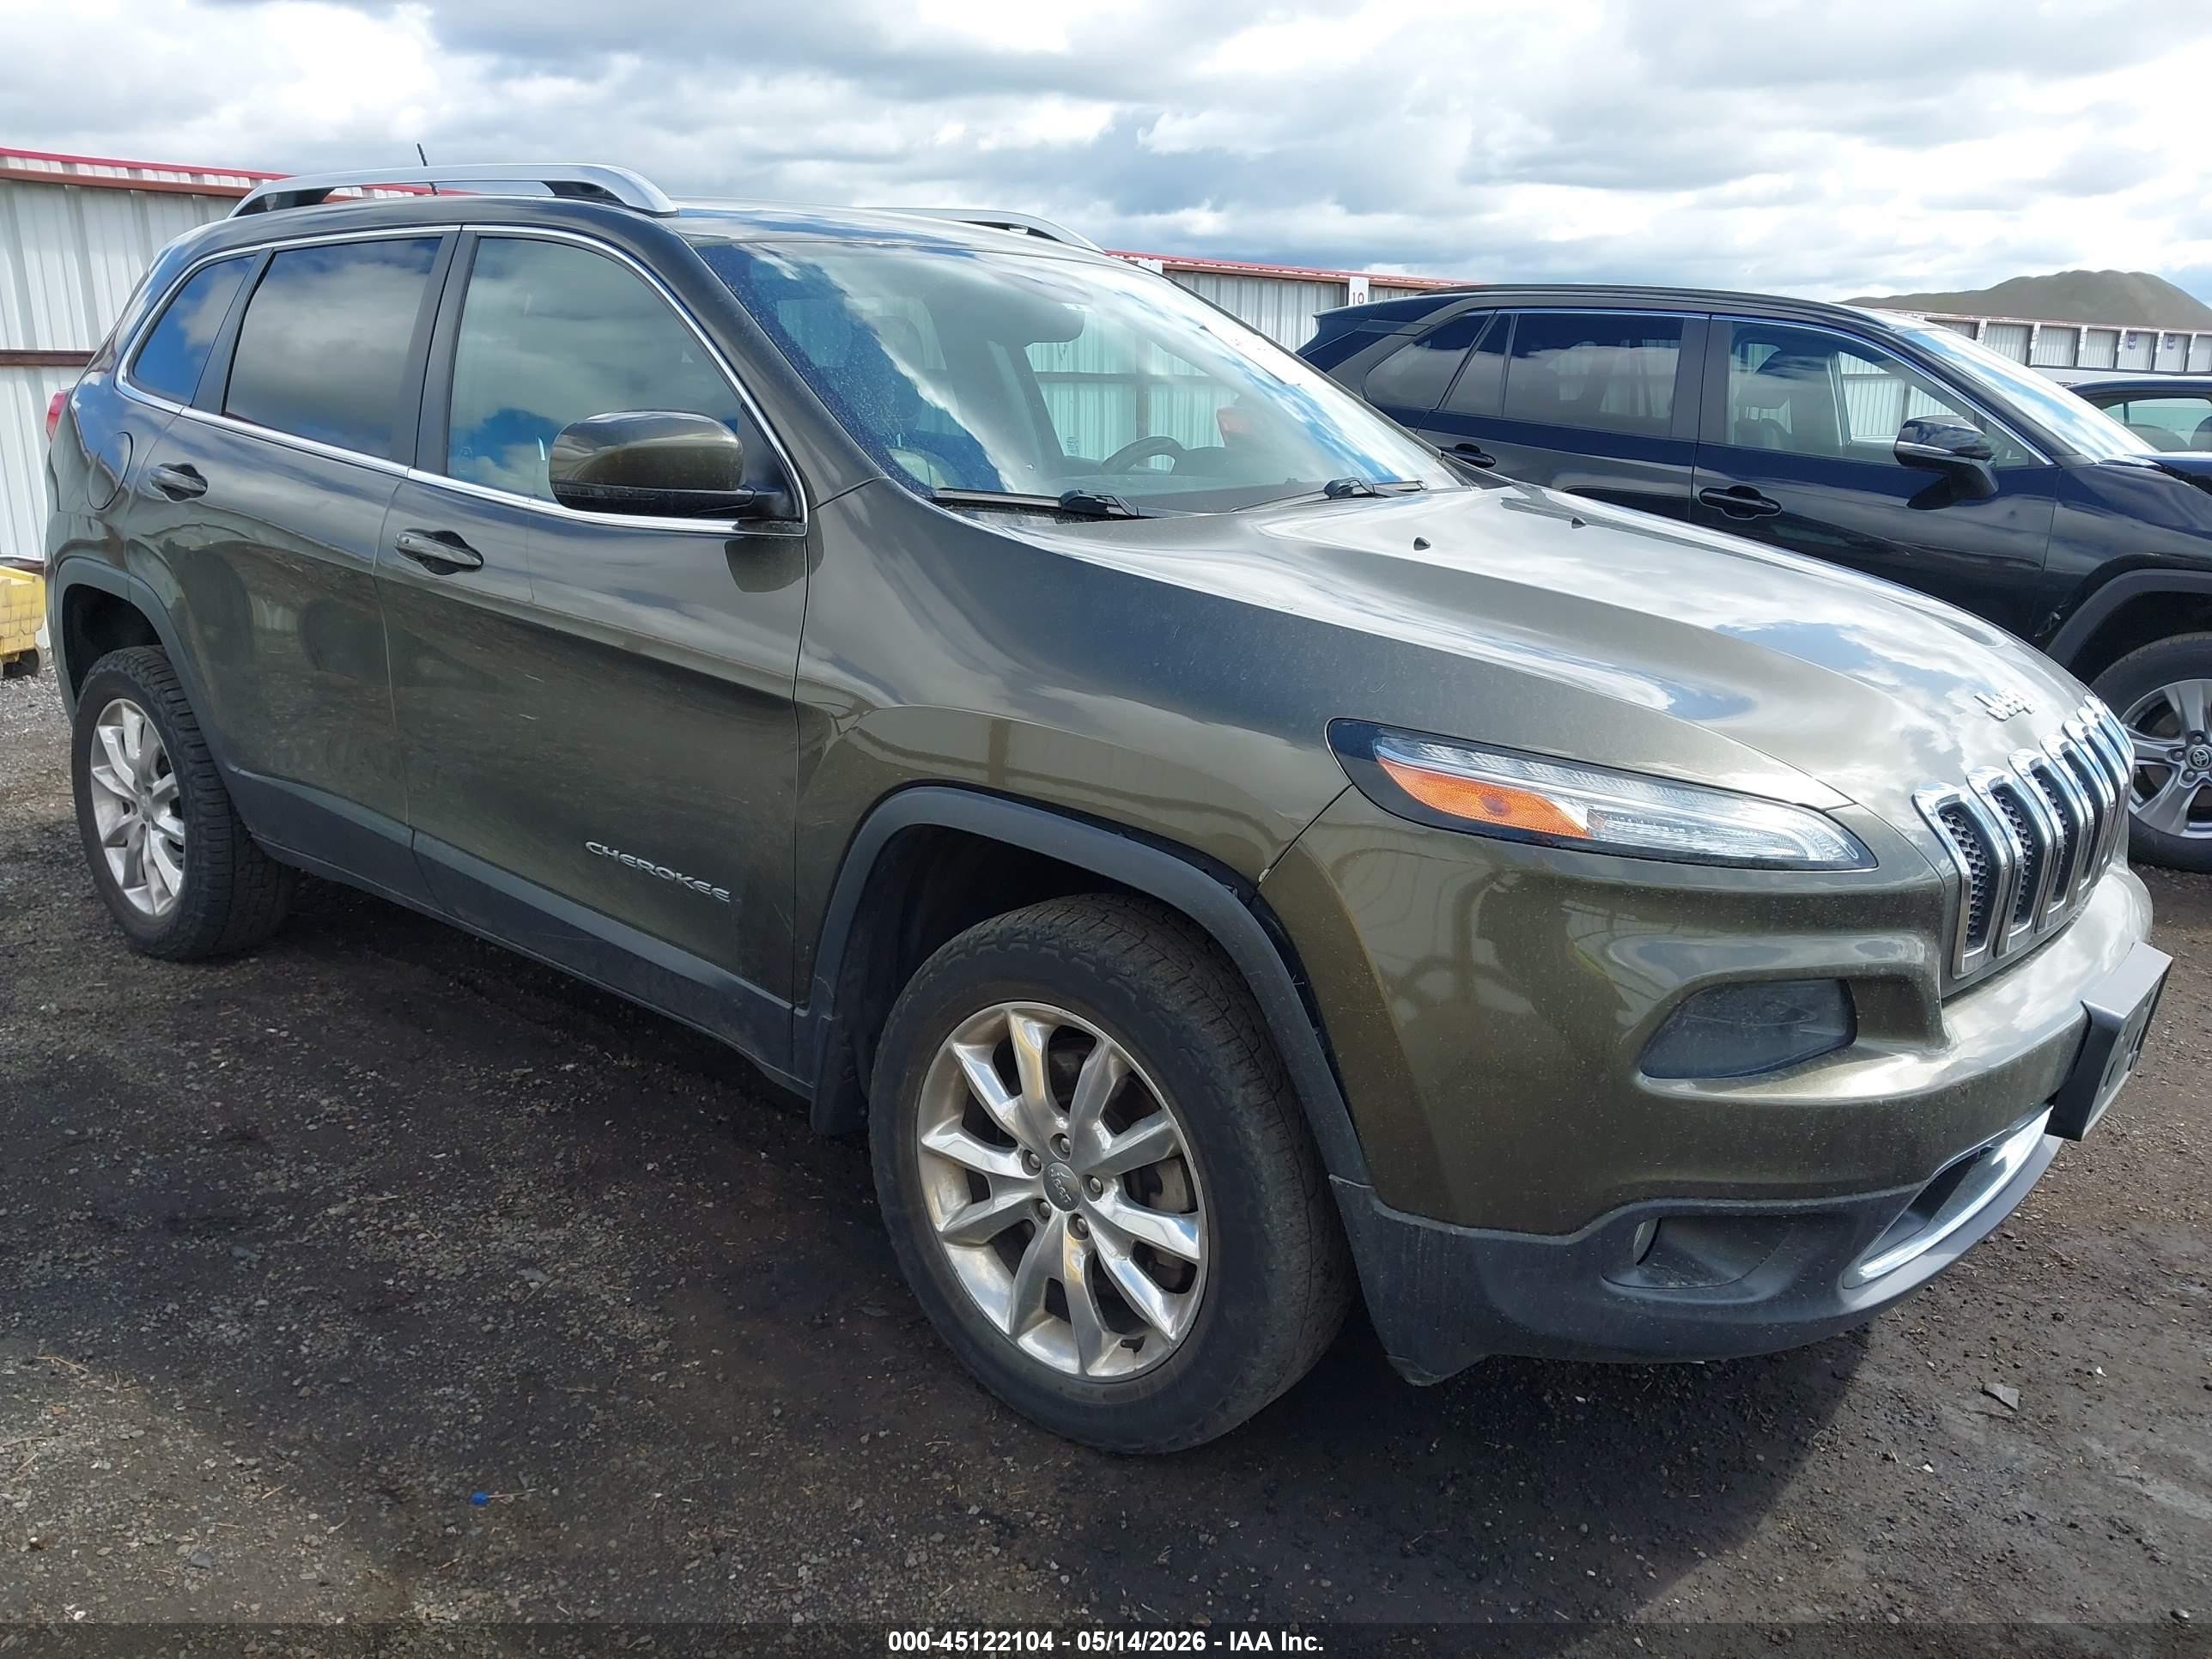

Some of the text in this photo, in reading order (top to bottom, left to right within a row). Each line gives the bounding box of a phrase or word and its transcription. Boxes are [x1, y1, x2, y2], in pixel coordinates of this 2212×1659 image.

[1352, 291, 1364, 305] 10
[1973, 686, 2036, 722] Jeep
[585, 841, 732, 902] CHEROKEE
